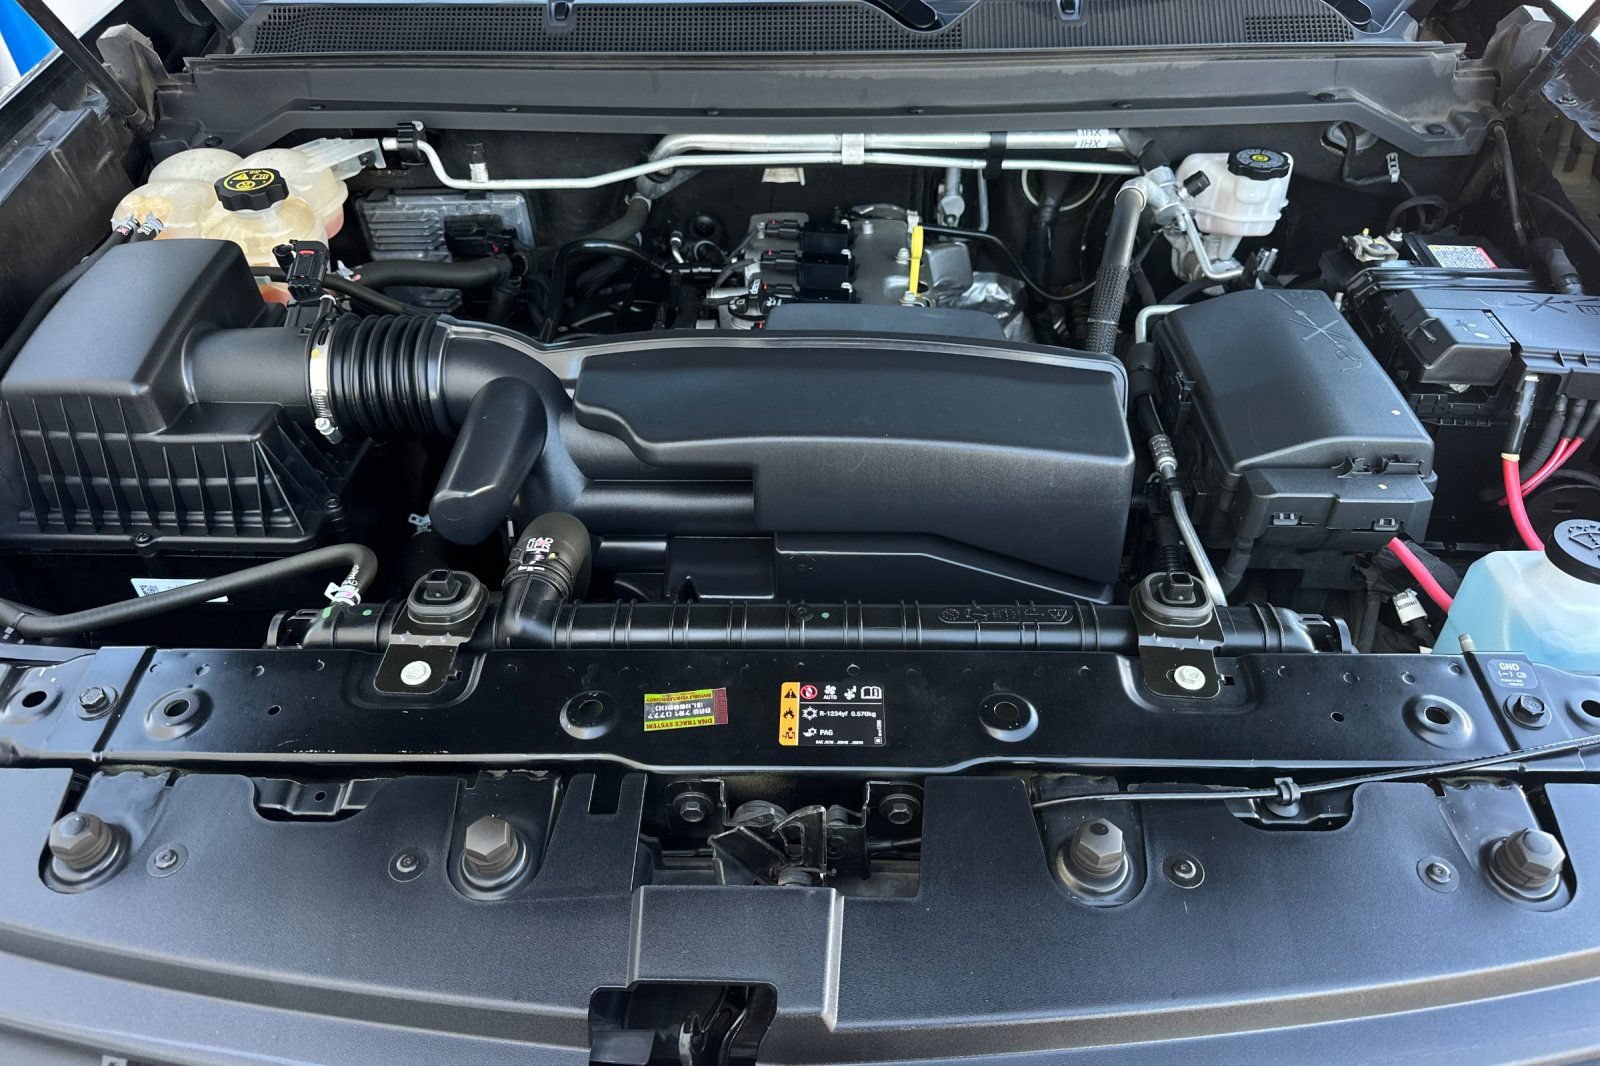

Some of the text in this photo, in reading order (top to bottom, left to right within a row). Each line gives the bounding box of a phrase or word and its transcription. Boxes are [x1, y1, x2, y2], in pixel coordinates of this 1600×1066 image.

[1499, 662, 1519, 671] GND
[819, 710, 848, 718] R-1234yf
[646, 721, 673, 730] SYSTEM
